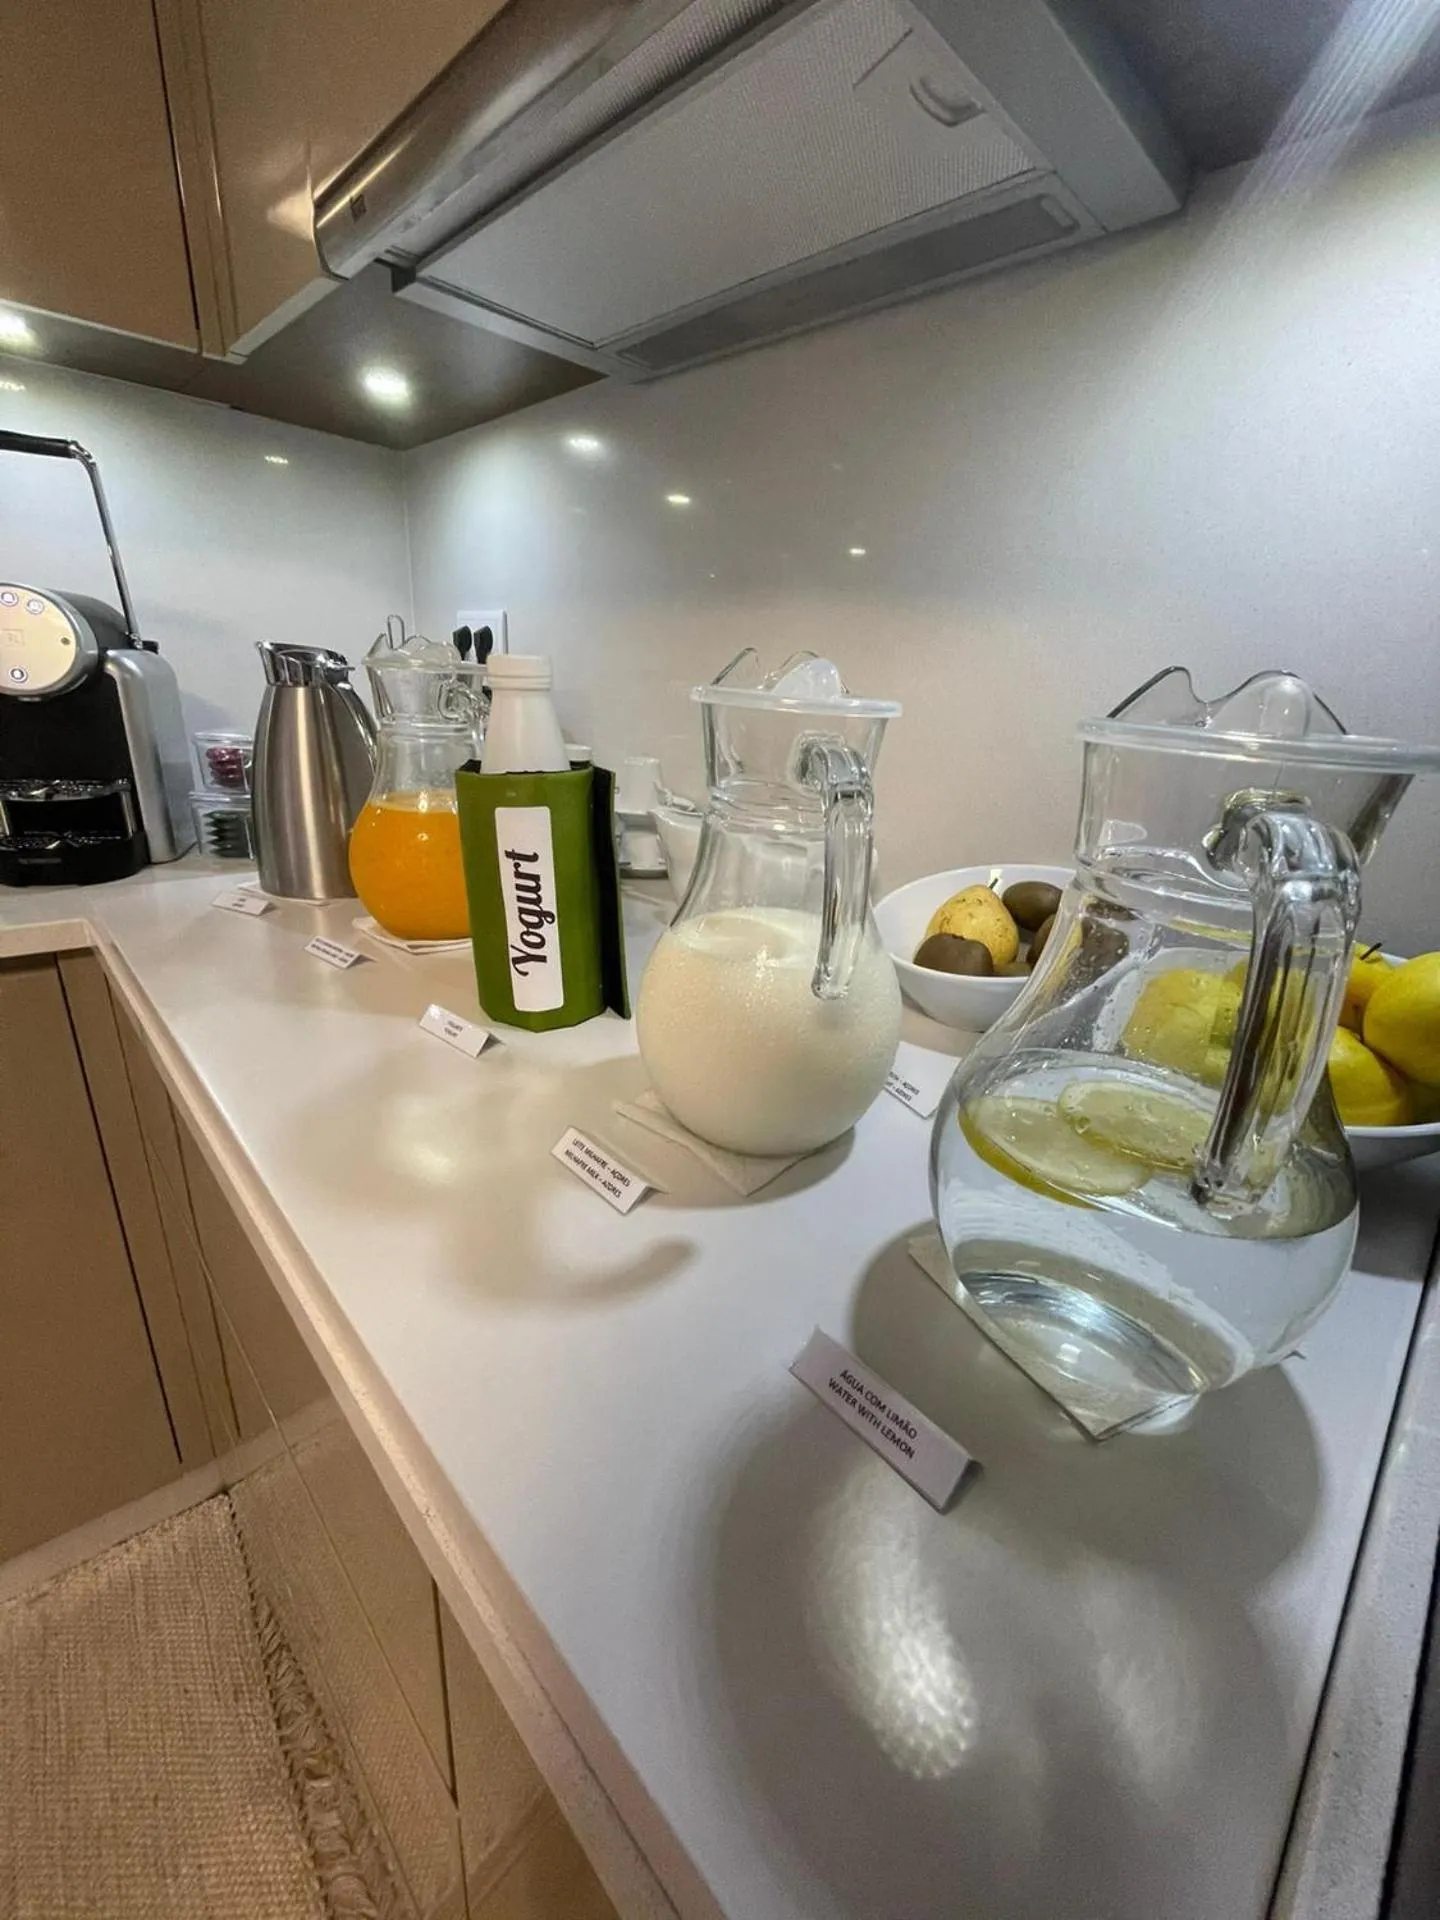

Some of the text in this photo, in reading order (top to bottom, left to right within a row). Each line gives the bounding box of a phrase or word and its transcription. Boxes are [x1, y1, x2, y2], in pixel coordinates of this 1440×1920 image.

[504, 849, 556, 977] Yogurt
[828, 1377, 915, 1459] WATER WITH LEMON
[864, 1390, 887, 1413] COM
[886, 1408, 917, 1439] LIMÃO
